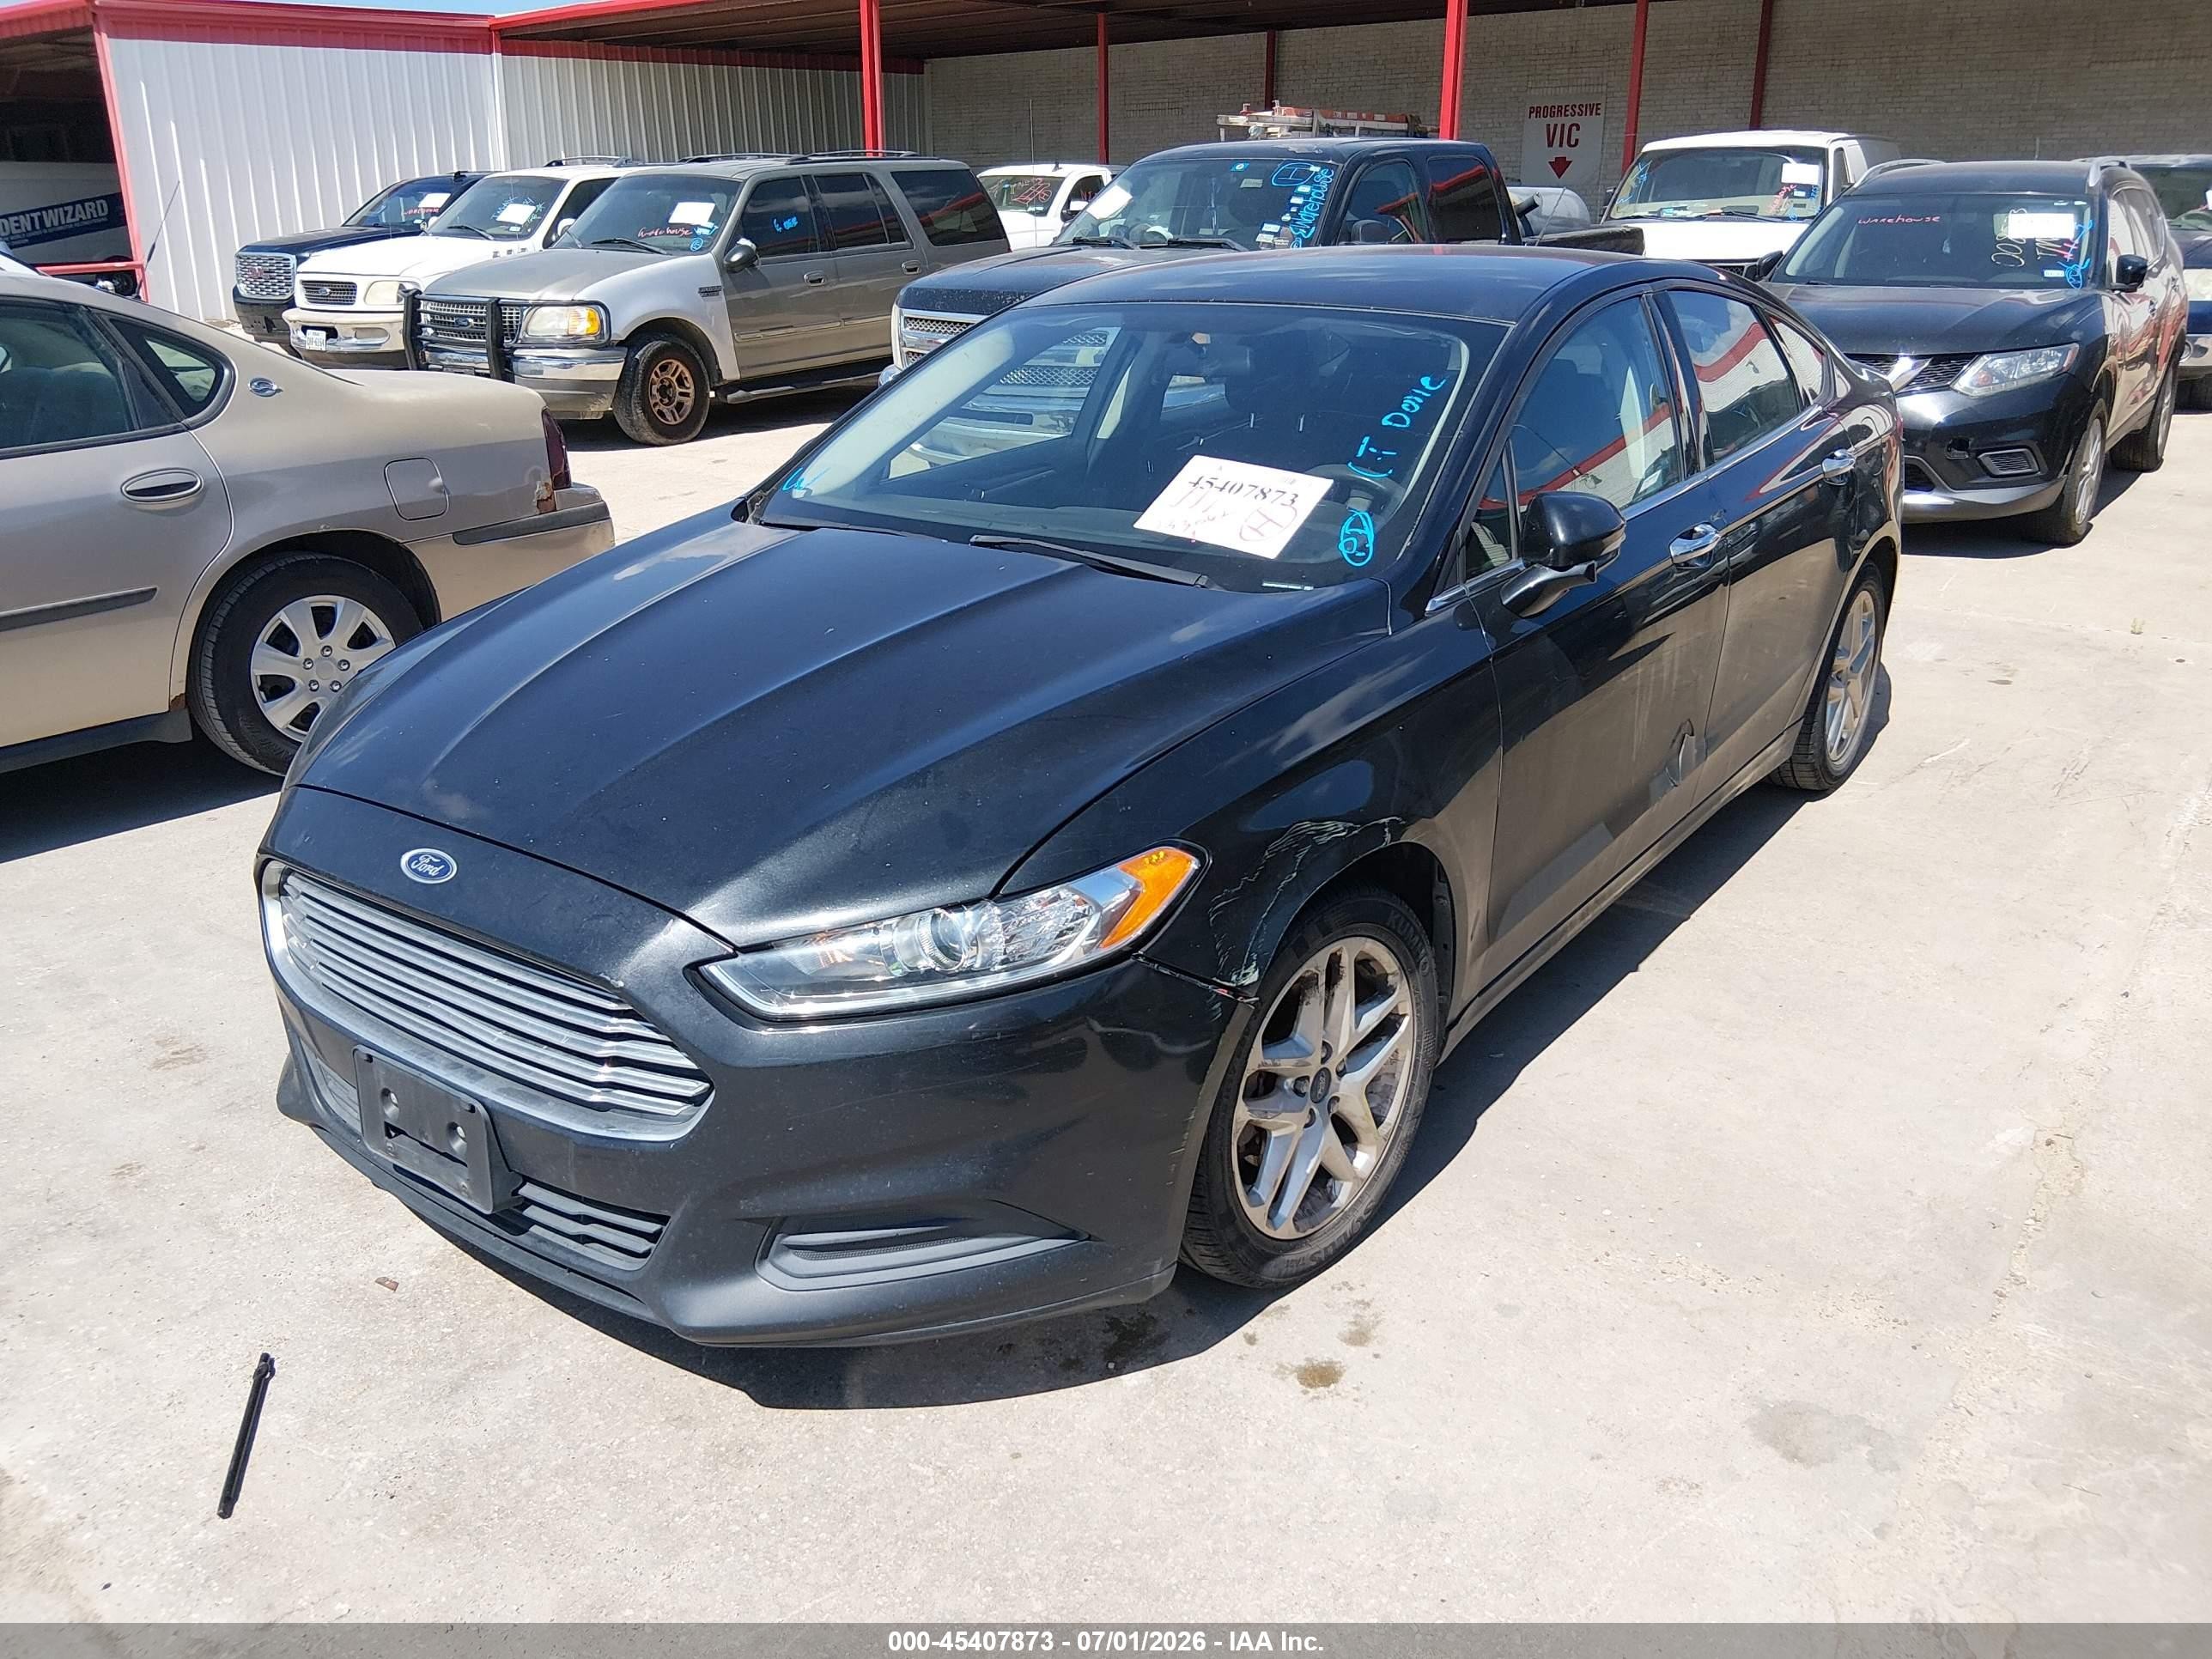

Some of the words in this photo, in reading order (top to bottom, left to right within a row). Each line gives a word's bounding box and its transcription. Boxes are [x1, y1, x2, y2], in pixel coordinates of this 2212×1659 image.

[1528, 102, 1601, 118] PROGRESSIVE
[1546, 123, 1581, 148] VIC
[0, 211, 42, 237] DENT
[41, 198, 109, 228] WIZARD
[1188, 475, 1300, 507] 45407873
[410, 854, 446, 877] Ford
